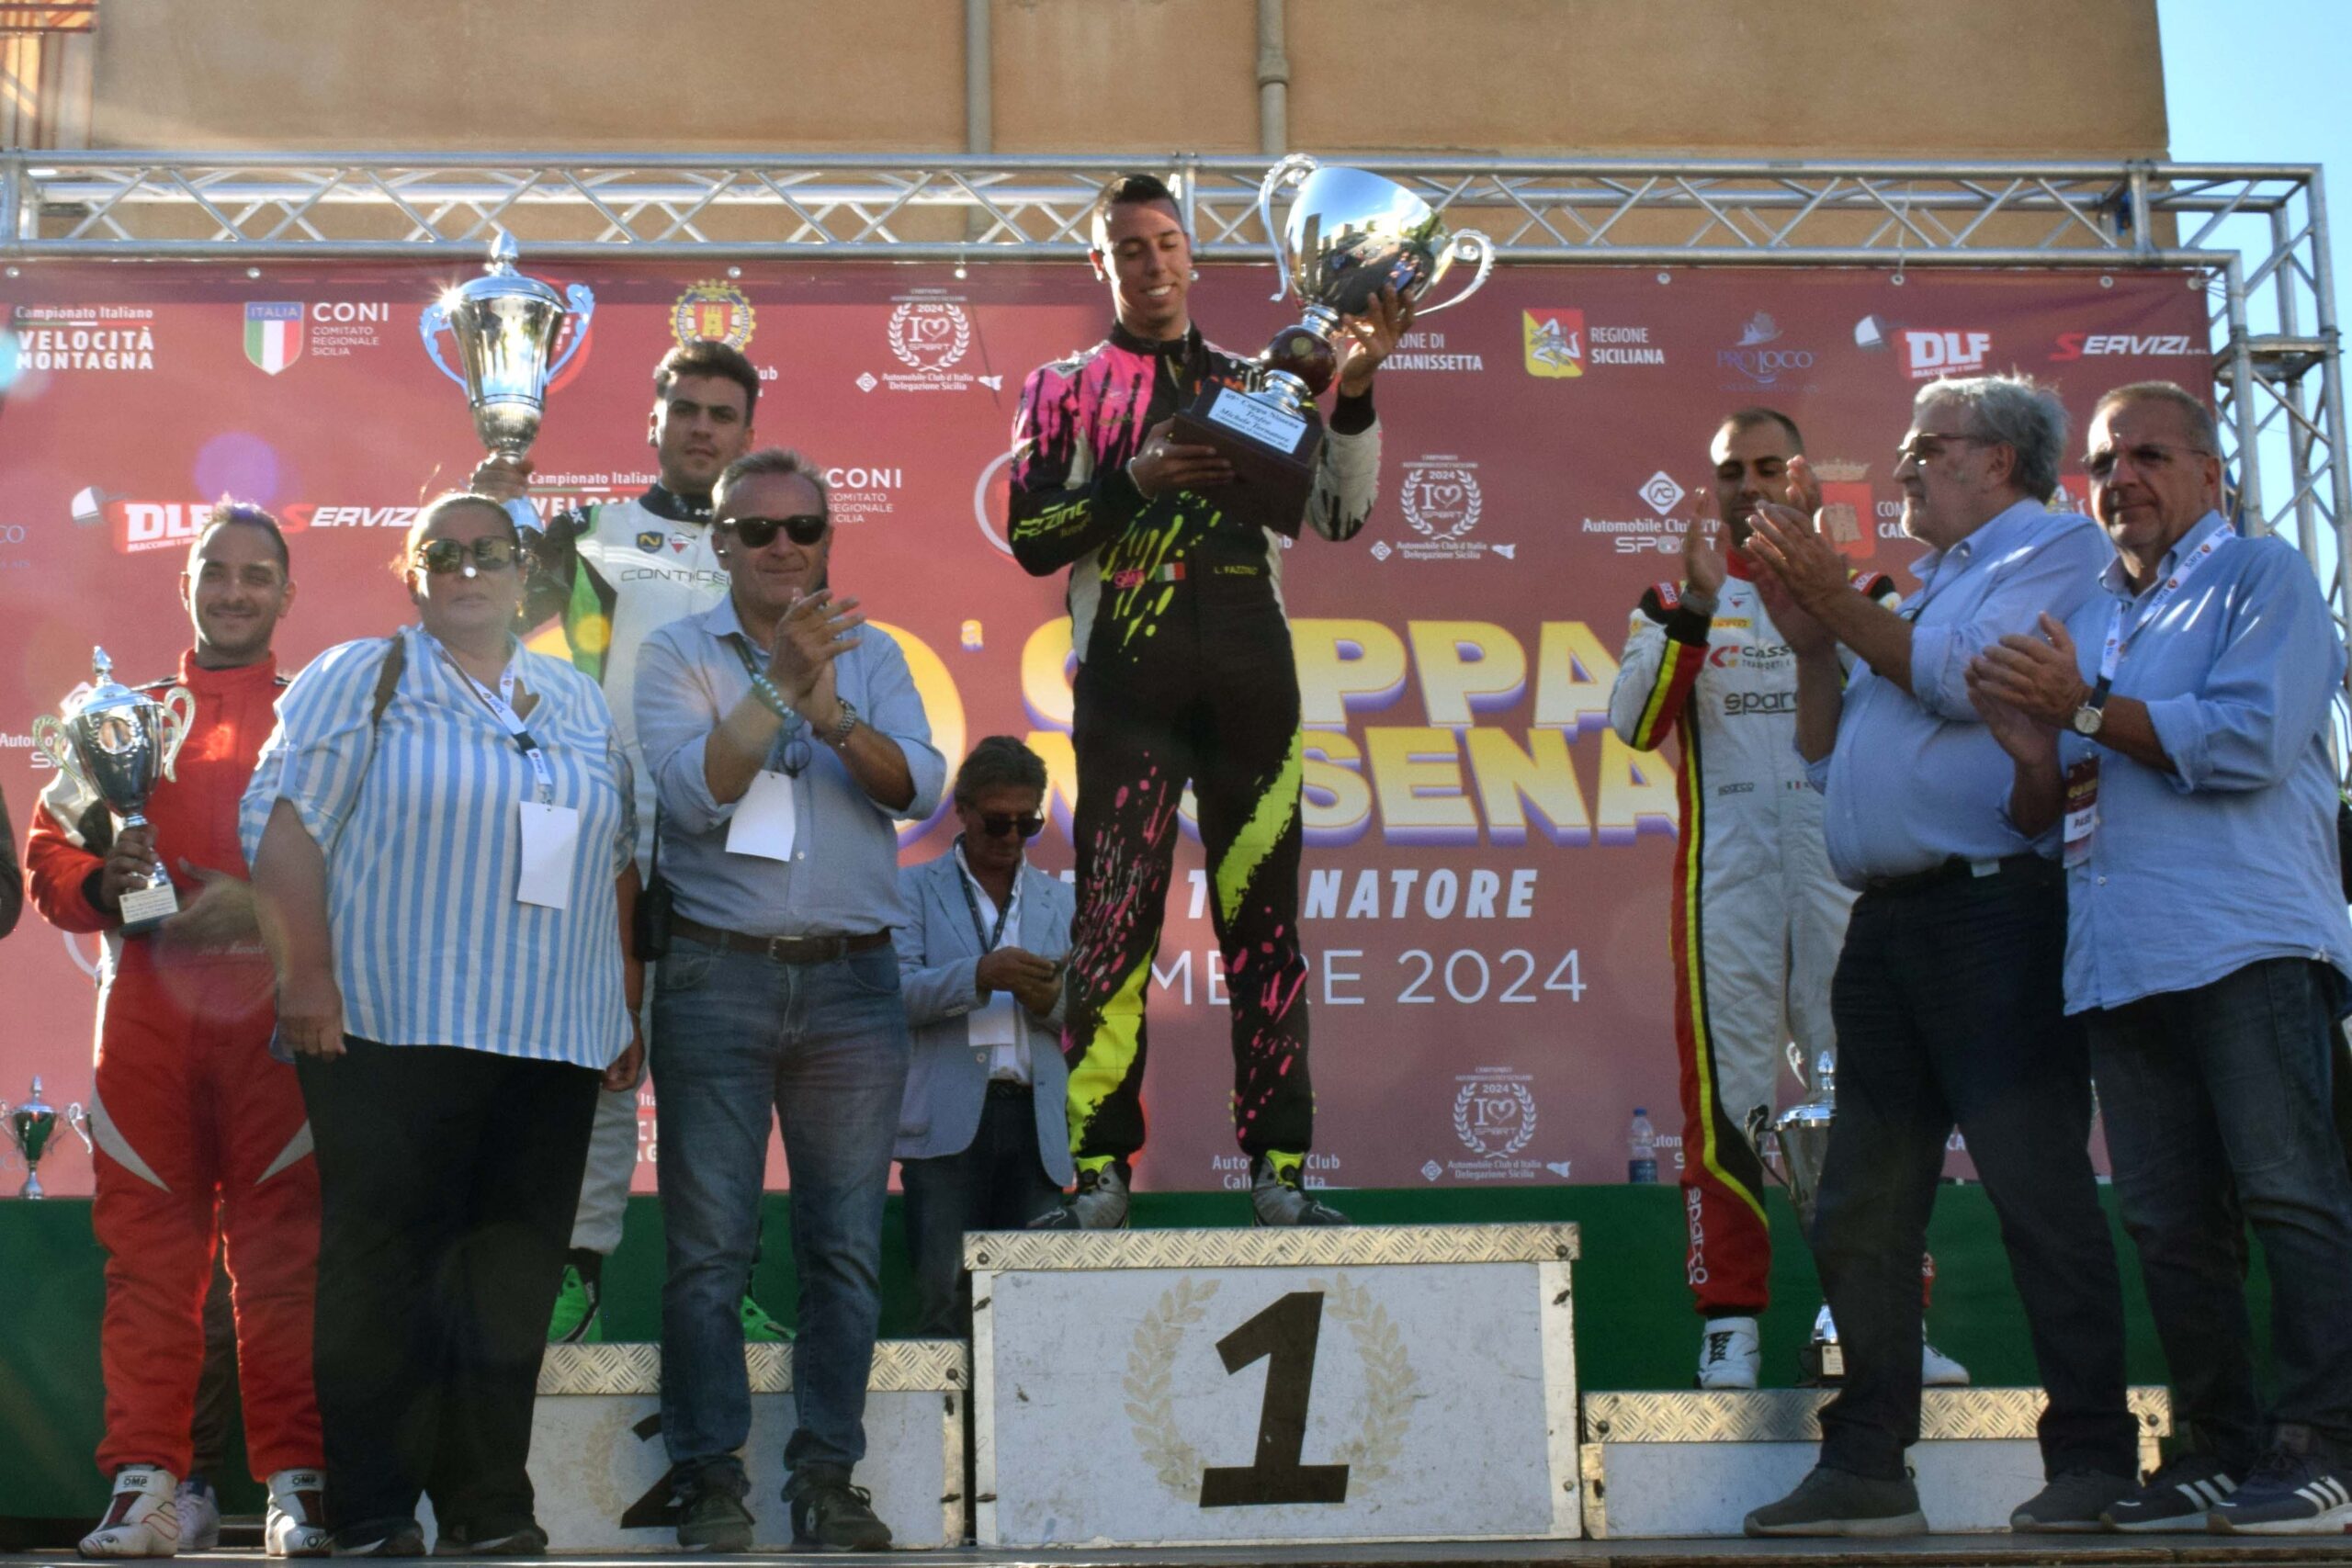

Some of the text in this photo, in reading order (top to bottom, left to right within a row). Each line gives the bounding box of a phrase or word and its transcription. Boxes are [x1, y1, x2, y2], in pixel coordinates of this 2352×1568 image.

[16, 306, 153, 321] Campionato Italiano
[311, 301, 390, 322] CONI
[916, 304, 944, 313] 2024
[17, 326, 154, 350] VELOCITÀ
[311, 326, 374, 336] COMITATO
[1589, 327, 1649, 344] REGIONE
[311, 336, 380, 346] REGIONALE
[1430, 333, 1445, 348] DI
[2050, 333, 2190, 362] SERVIZI
[311, 346, 350, 356] SICILIA
[1590, 348, 1665, 365] SICILIANA
[1905, 332, 1991, 368] DLF
[15, 352, 153, 369] MONTAGNA
[1377, 355, 1484, 370] ALTANISSETTA
[527, 471, 660, 486] Campionato Italian
[826, 468, 901, 489] CONI
[1430, 471, 1455, 479] 2024
[1582, 518, 1662, 533] Automobile
[1724, 692, 1797, 716] spar
[1188, 869, 1538, 919] TNATORE
[1396, 949, 1588, 1004] 2024
[1483, 1084, 1509, 1093] 2024
[1306, 1155, 1340, 1169] Club
[1199, 1292, 1350, 1508] 1
